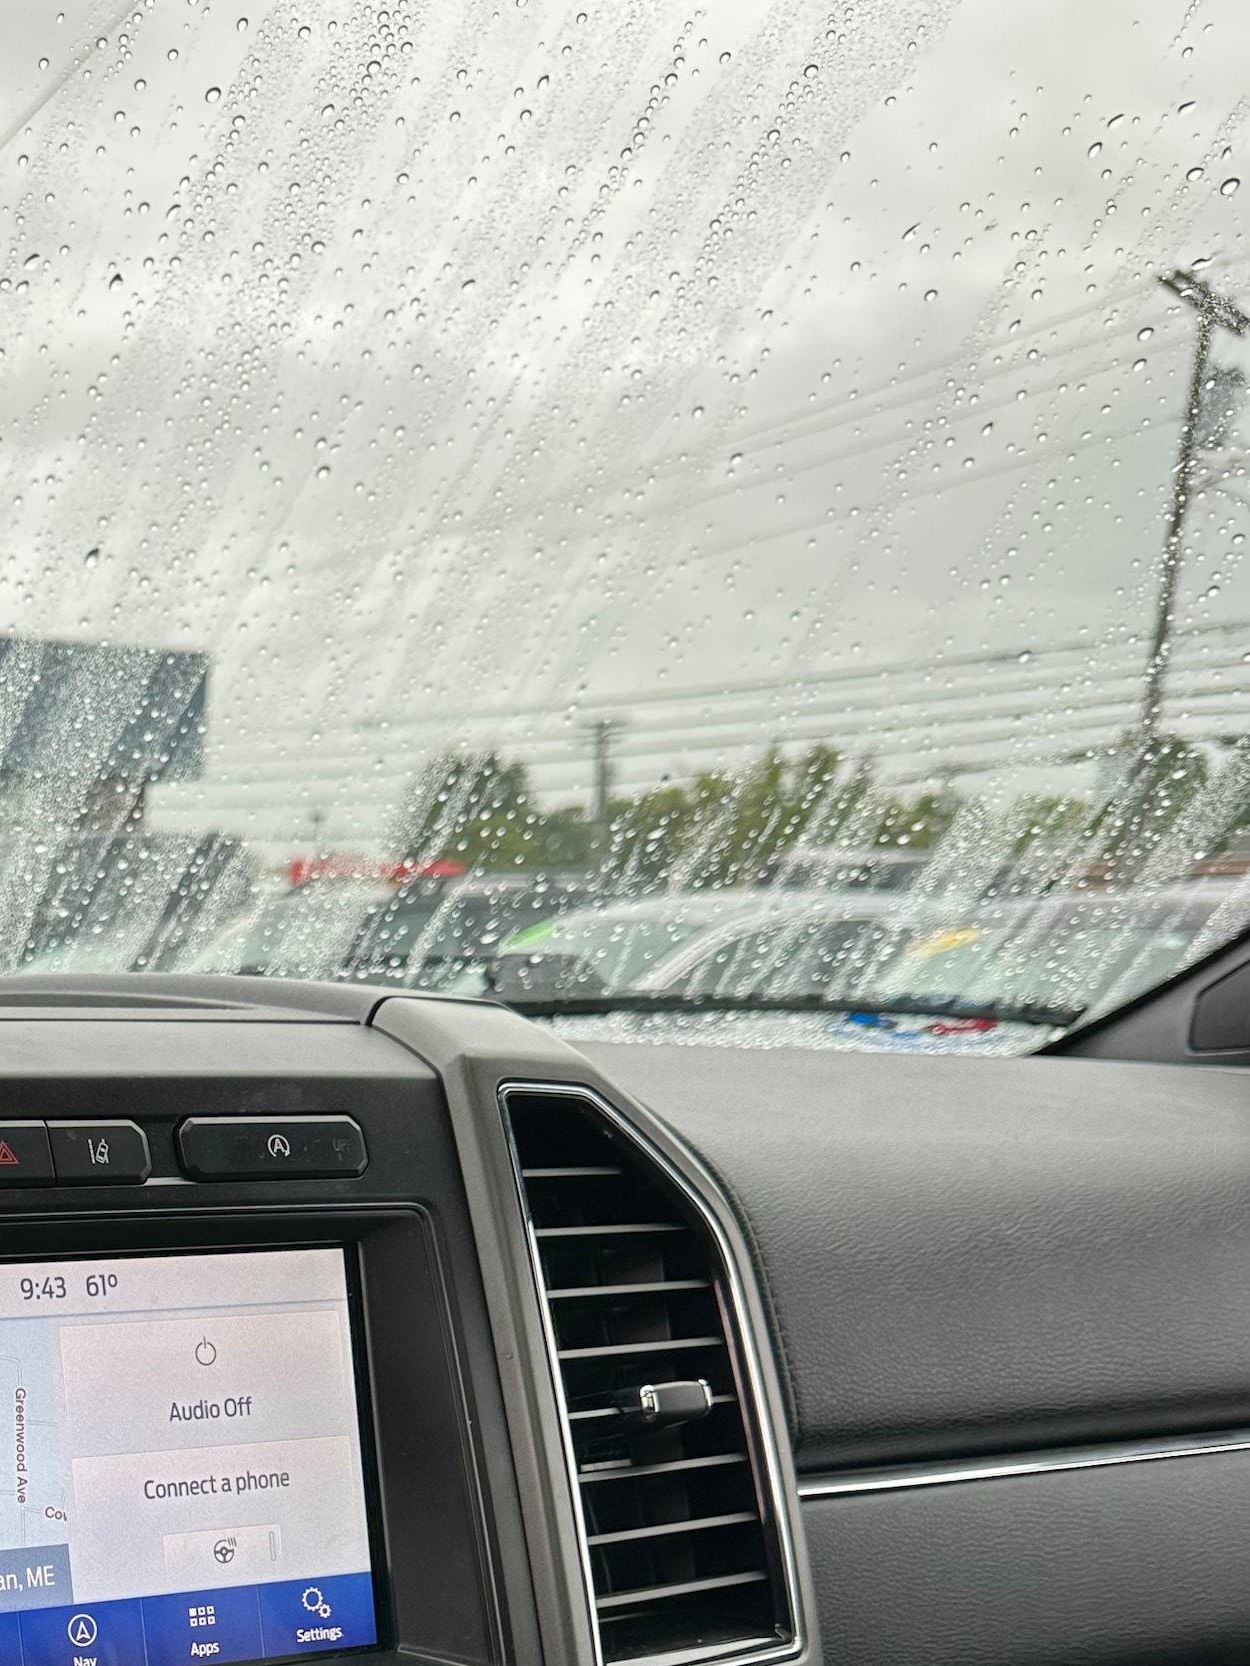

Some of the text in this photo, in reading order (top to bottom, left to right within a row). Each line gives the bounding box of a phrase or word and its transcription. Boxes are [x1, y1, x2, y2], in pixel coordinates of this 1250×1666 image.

[20, 1276, 66, 1300] 9:43
[170, 1396, 252, 1422] Audio Off
[15, 1387, 27, 1504] Greenwood Ave
[144, 1471, 290, 1500] Connect a phone
[26, 1565, 55, 1588] ME
[296, 1625, 343, 1643] Settings
[190, 1641, 220, 1657] Apps
